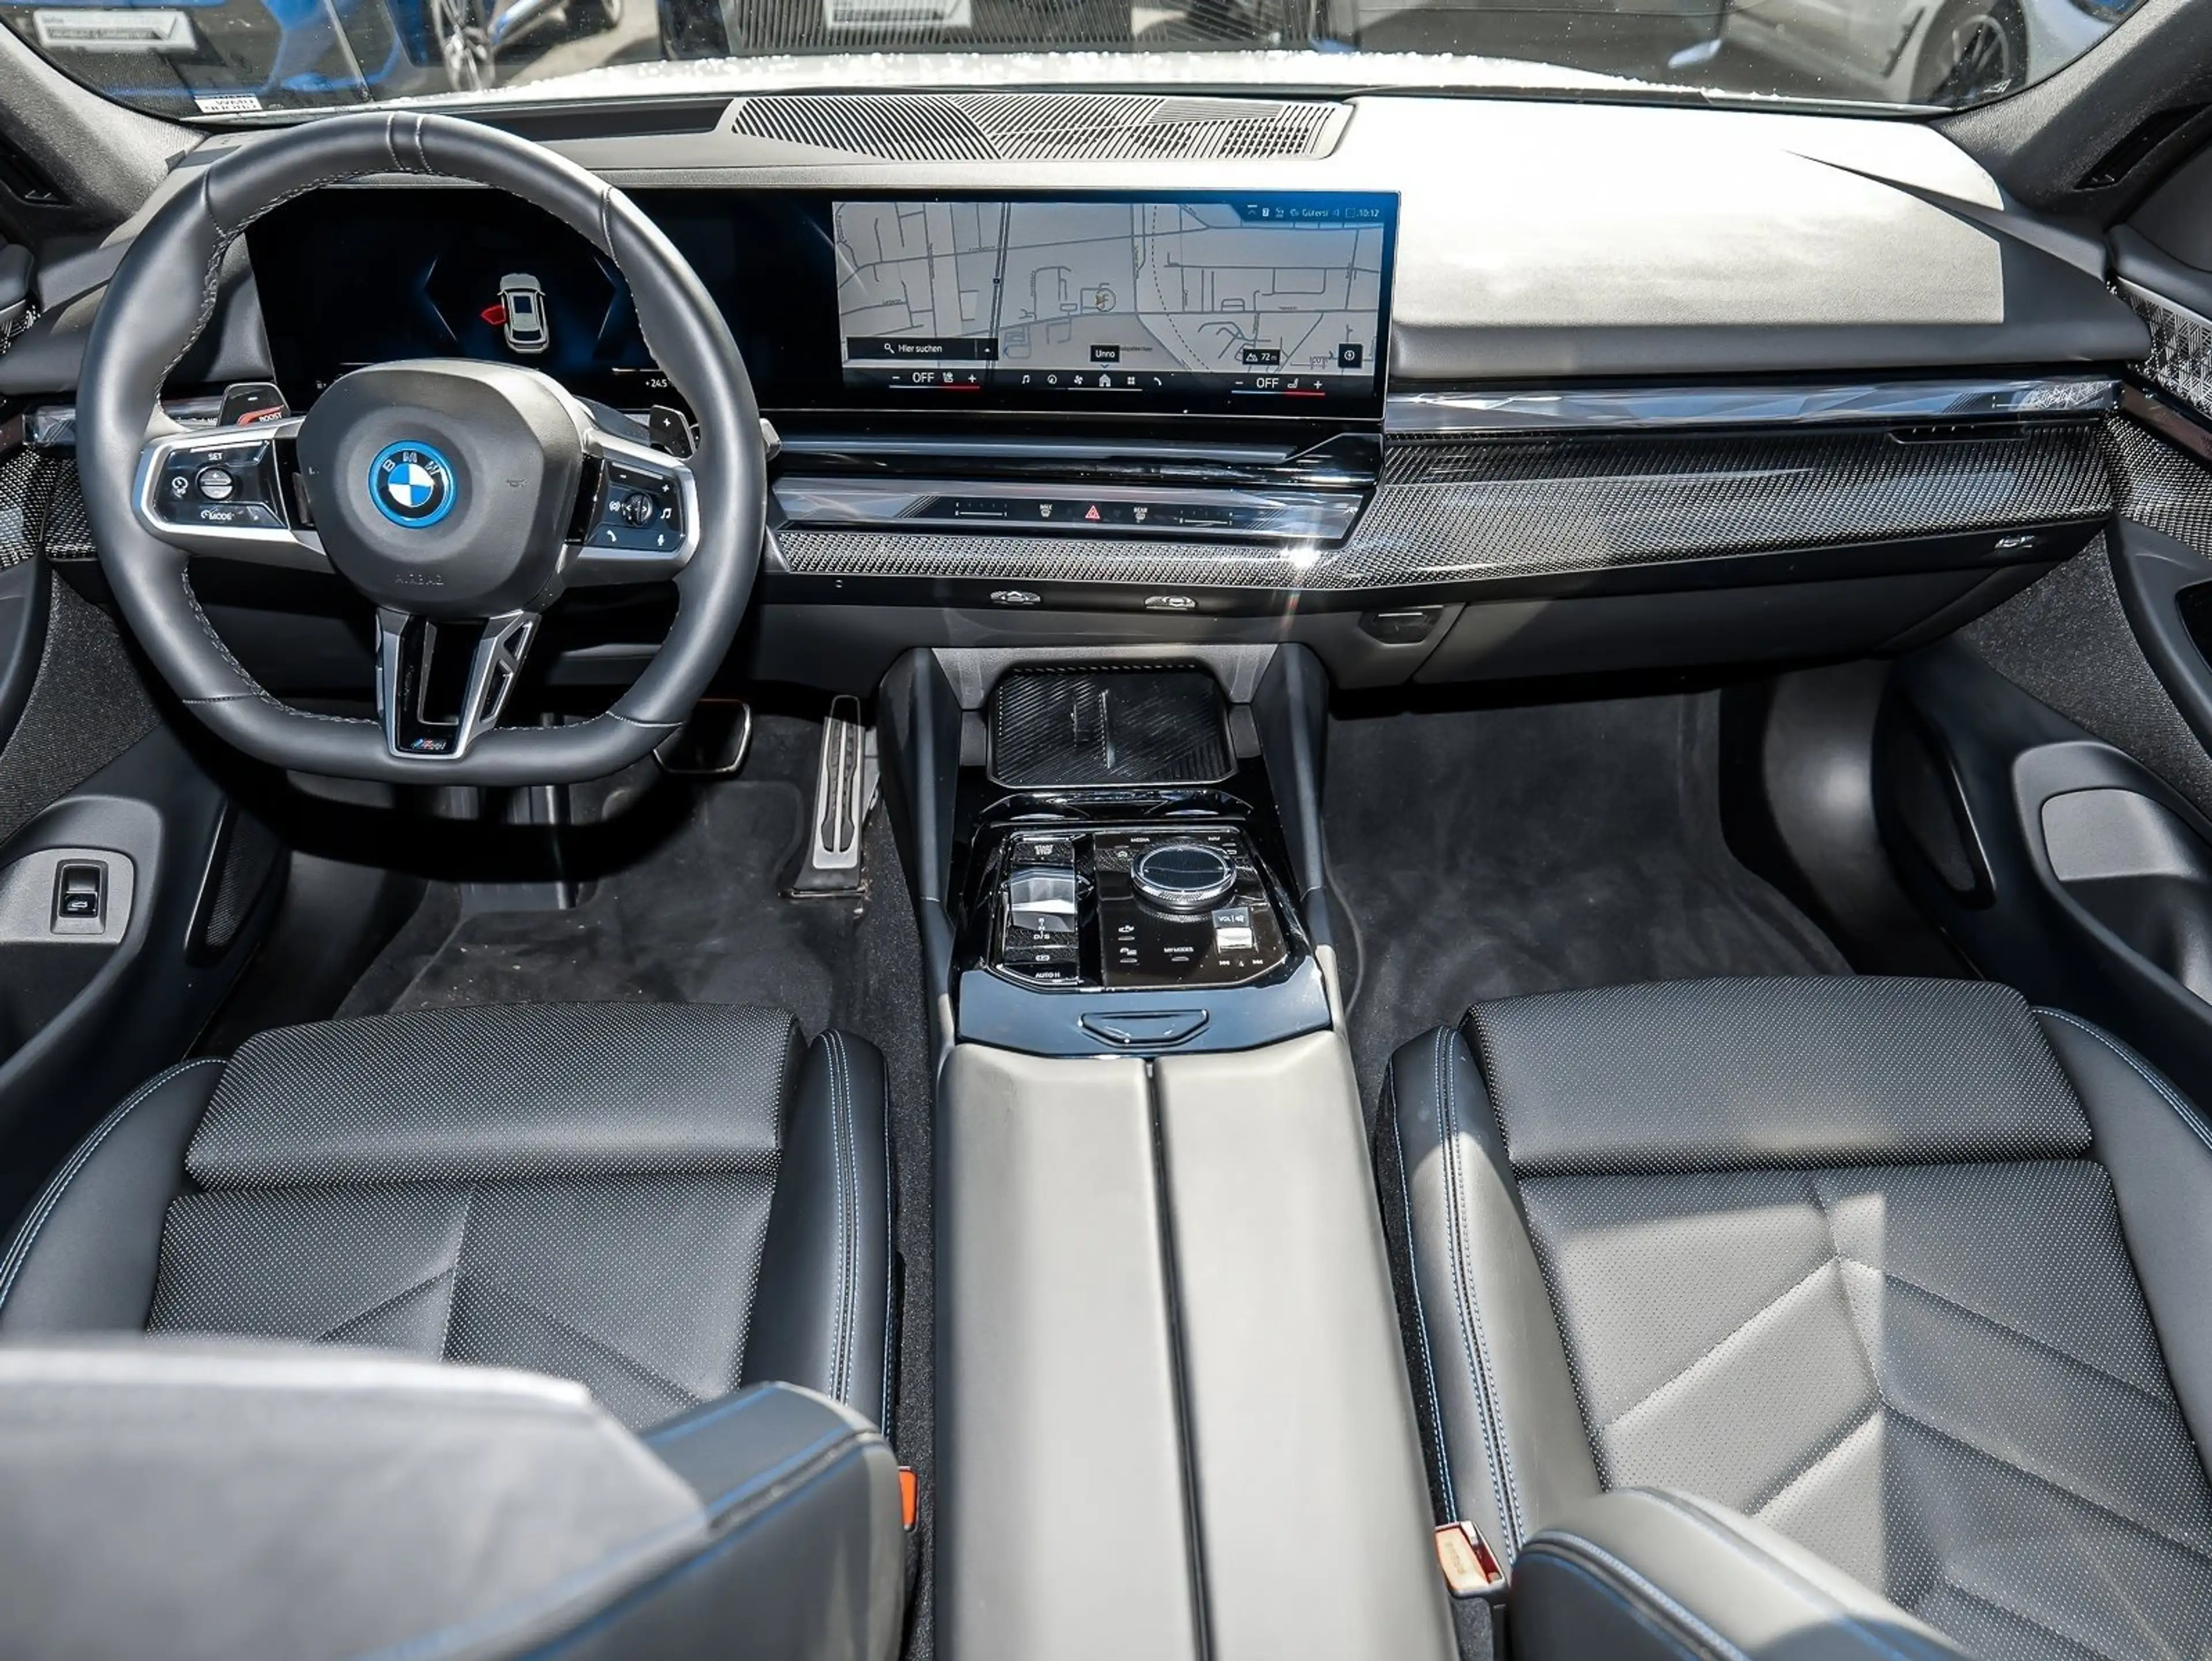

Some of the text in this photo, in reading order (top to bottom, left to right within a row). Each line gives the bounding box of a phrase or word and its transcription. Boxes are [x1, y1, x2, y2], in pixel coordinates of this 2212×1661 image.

[898, 344, 942, 353] Hier suchen
[912, 372, 935, 383] OFF
[1256, 378, 1279, 388] OFF
[208, 453, 223, 461] SET
[382, 451, 440, 476] BMW
